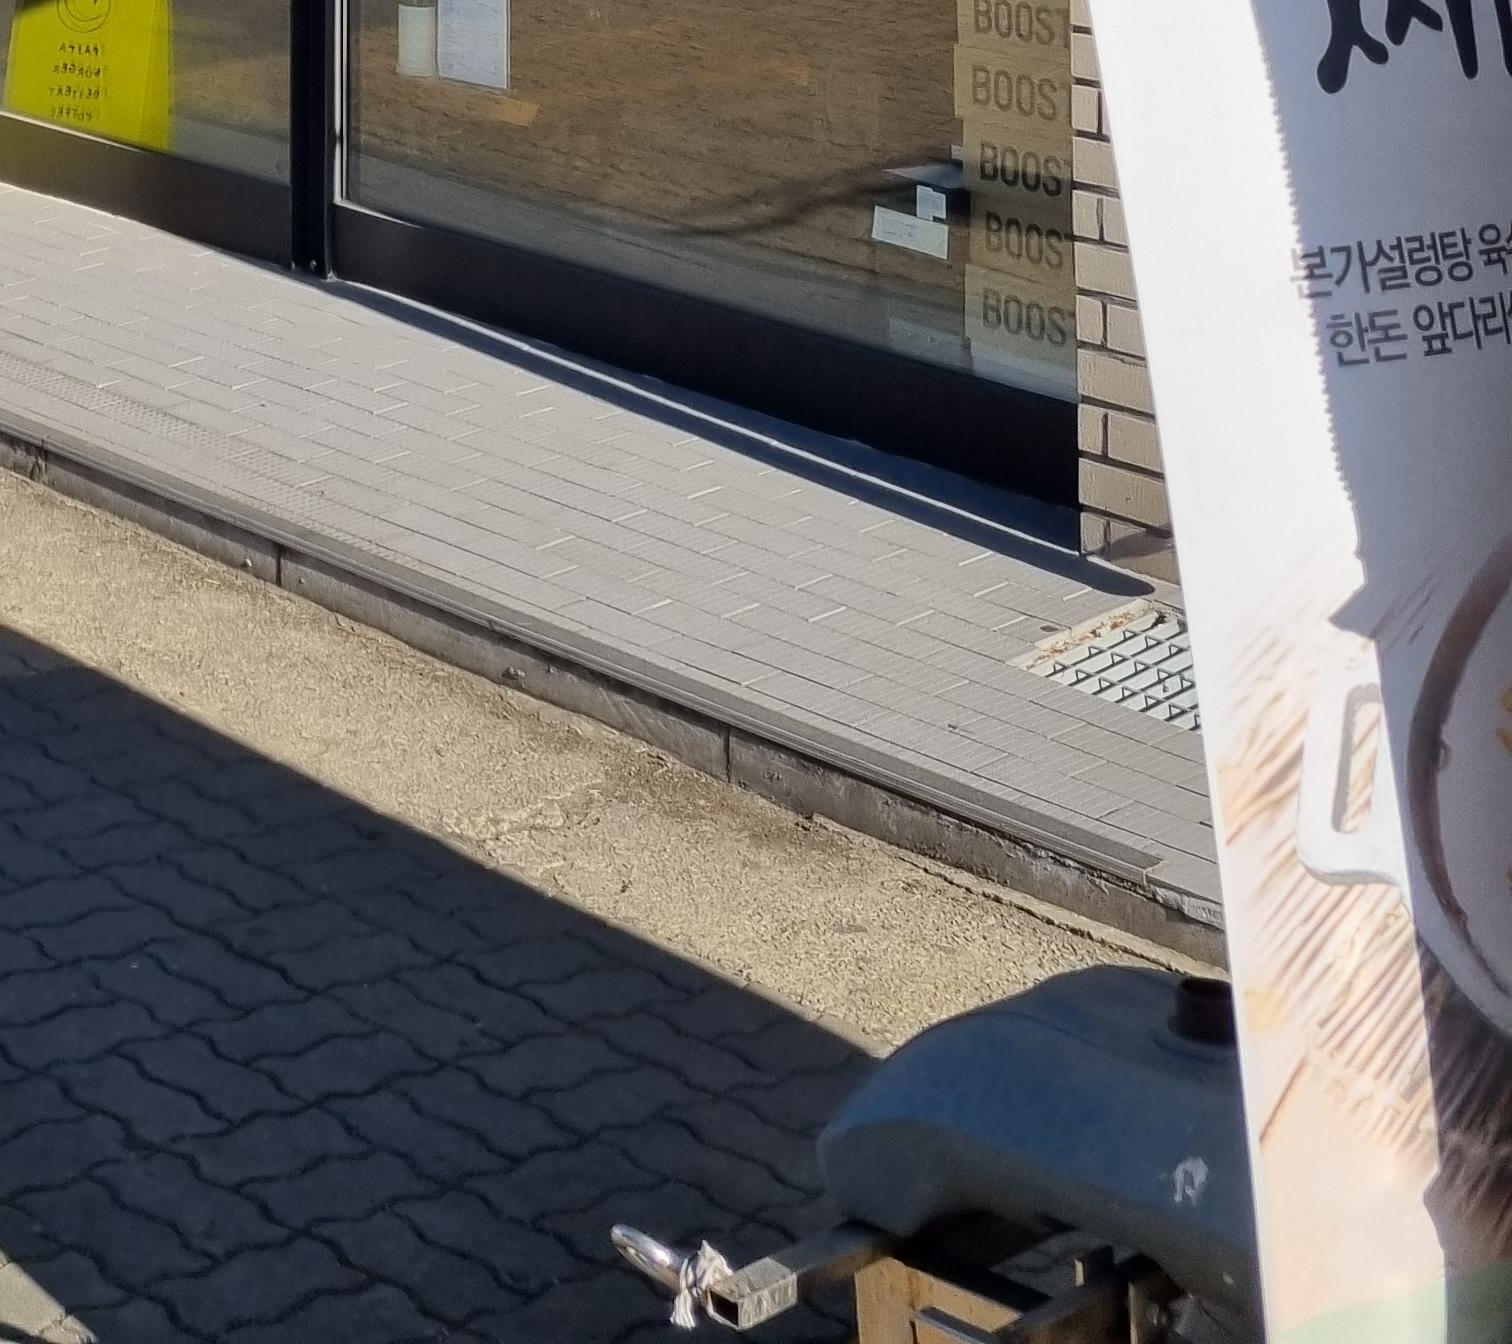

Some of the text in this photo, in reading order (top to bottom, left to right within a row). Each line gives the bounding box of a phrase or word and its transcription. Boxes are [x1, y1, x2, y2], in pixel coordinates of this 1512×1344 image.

[1289, 222, 1512, 300] 본가설렁탕 육
[1326, 290, 1512, 368] 한돈 앞다리
